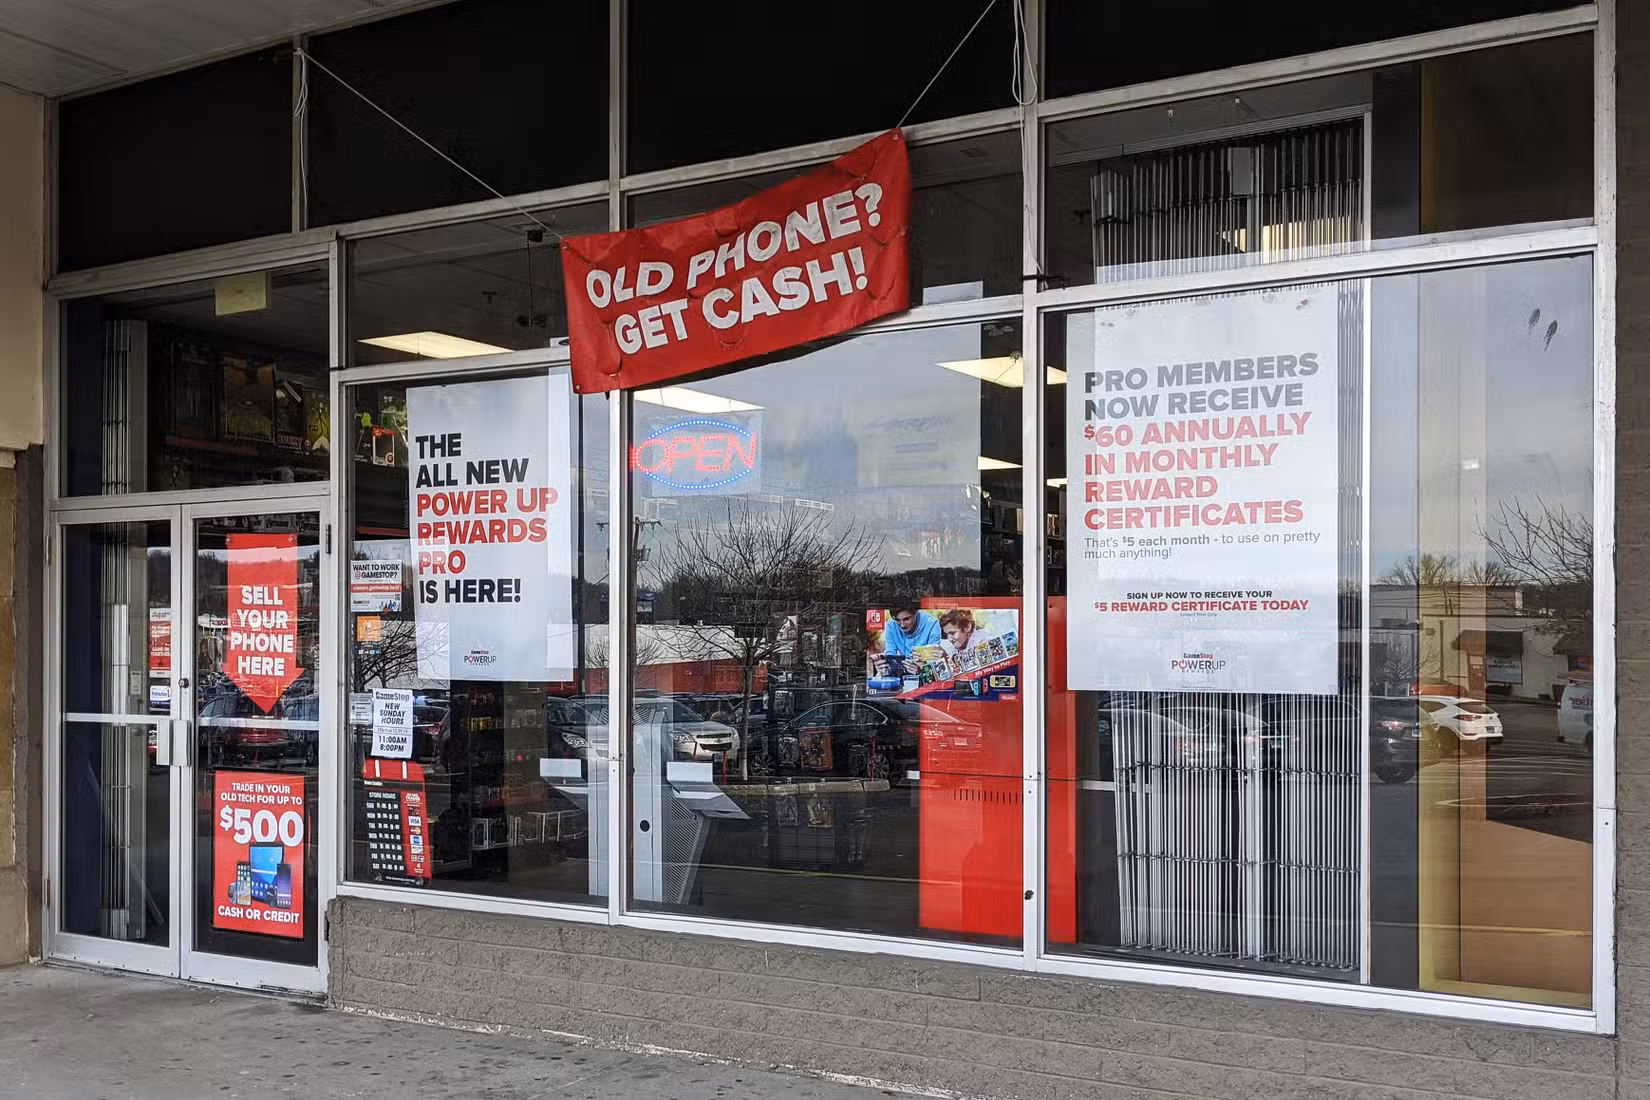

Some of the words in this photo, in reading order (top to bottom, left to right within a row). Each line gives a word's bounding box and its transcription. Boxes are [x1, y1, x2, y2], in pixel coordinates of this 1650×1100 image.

[586, 261, 674, 309] OLD
[687, 183, 883, 290] PHONE?
[614, 298, 689, 355] GET
[702, 246, 868, 330] CASH!
[1084, 367, 1148, 393] PRO
[1157, 352, 1319, 388] MEMBERS
[1084, 394, 1160, 421] NOW
[1167, 382, 1304, 415] RECEIVE
[1084, 423, 1134, 447] $60
[1141, 411, 1312, 445] ANNUALLY
[415, 433, 462, 459] THE
[636, 431, 758, 474] OPEN
[1085, 453, 1116, 476] IN
[1125, 442, 1279, 474] MONTHLY
[416, 463, 458, 489] ALL
[466, 458, 529, 485] NEW
[1085, 475, 1218, 503] REWARD
[417, 490, 508, 517] POWER
[516, 487, 559, 513] UP
[1084, 500, 1304, 530] CERTIFICATES
[418, 518, 547, 547] REWARDS
[1084, 537, 1118, 548] That's
[1122, 536, 1135, 547] $5
[1138, 536, 1167, 547] each
[1170, 535, 1210, 546] month
[1222, 534, 1234, 544] to
[1238, 534, 1259, 544] use
[1263, 533, 1279, 543] on
[1283, 531, 1320, 544] pretty
[418, 550, 466, 575] PRO
[1084, 548, 1116, 559] much
[1119, 547, 1172, 560] anything!
[355, 571, 398, 579] @GAMESTOP?
[380, 563, 400, 571] WORK
[241, 586, 283, 605] SELL
[419, 581, 438, 604] IS
[445, 579, 521, 604] HERE!
[1127, 592, 1148, 600] SIGN
[1150, 592, 1163, 600] UP
[1165, 591, 1187, 599] NOW
[1190, 591, 1203, 599] TO
[1204, 591, 1243, 599] RECEIVE
[1245, 590, 1273, 598] YOUR
[1094, 602, 1108, 612] $5
[1111, 601, 1168, 612] REWARD
[1171, 600, 1257, 612] CERTIFICATE
[1261, 600, 1309, 611] TODAY
[237, 609, 288, 629] YOUR
[230, 632, 294, 653] PHONE
[238, 655, 285, 677] HERE
[376, 692, 409, 702] GameStop
[385, 702, 400, 710] NEW
[381, 717, 404, 725] HOURS
[379, 736, 407, 744] 11:00AM
[380, 744, 404, 752] 8:00PM
[221, 792, 237, 802] OLD
[238, 794, 255, 803] TECH
[257, 795, 275, 804] FOR
[277, 795, 290, 805] UP
[291, 796, 303, 805] TO
[232, 783, 254, 792] TRADE
[255, 784, 264, 793] IN
[266, 784, 290, 794] YOUR
[220, 805, 304, 847] $500
[218, 905, 244, 919] CASH
[246, 909, 261, 920] OR
[264, 910, 299, 924] CREDIT
